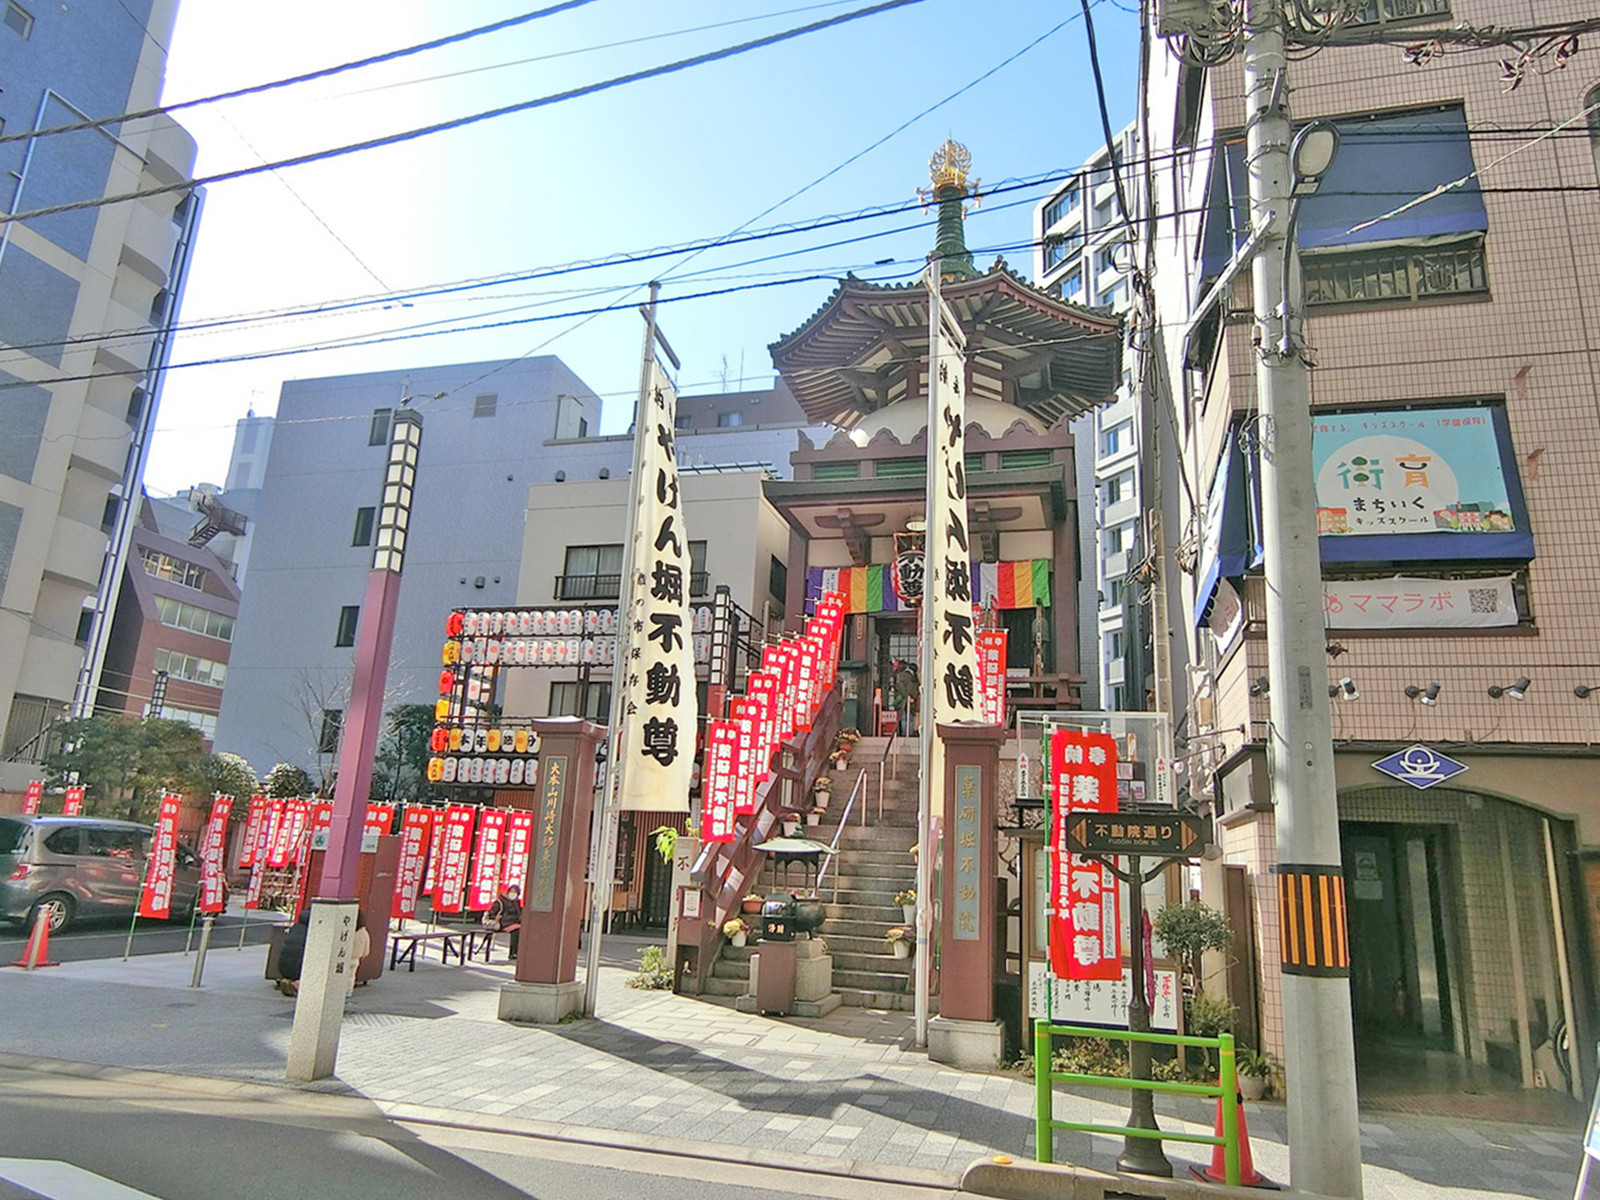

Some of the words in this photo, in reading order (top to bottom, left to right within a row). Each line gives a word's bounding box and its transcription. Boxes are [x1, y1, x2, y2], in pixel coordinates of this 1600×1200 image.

[1352, 496, 1426, 514] まちいく
[1355, 516, 1430, 527] キッズスクール
[1348, 590, 1455, 615] ママラボ
[1094, 823, 1173, 840] 不動院通り
[957, 773, 978, 934] 薬研堀不動院
[335, 914, 352, 974] やげん堀
